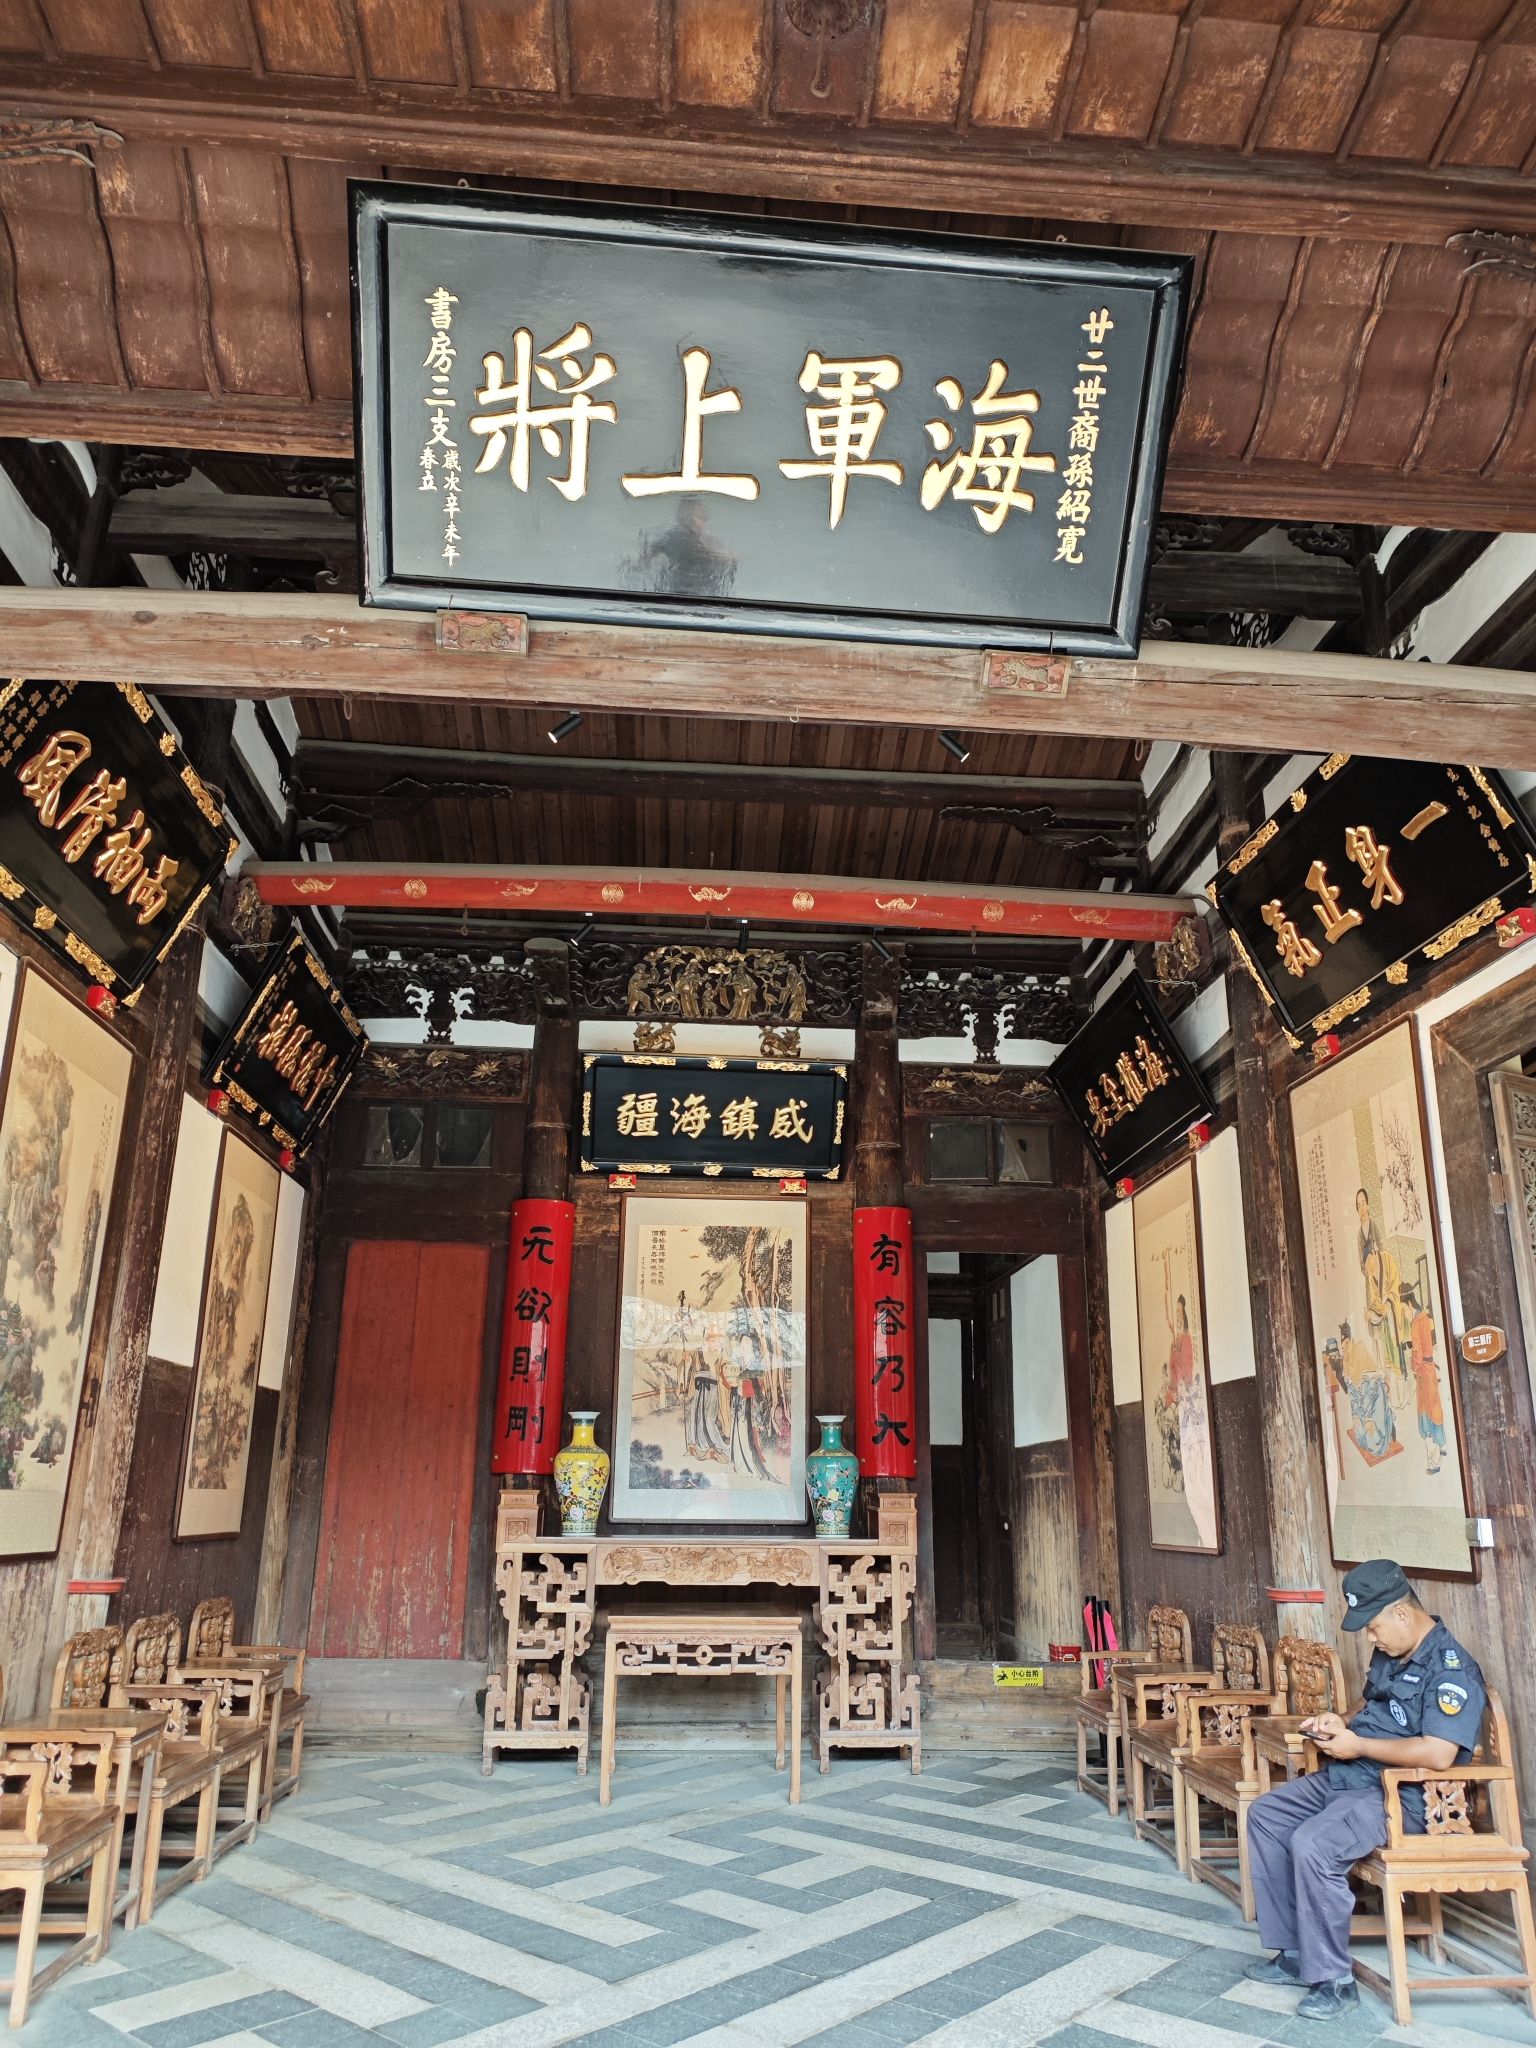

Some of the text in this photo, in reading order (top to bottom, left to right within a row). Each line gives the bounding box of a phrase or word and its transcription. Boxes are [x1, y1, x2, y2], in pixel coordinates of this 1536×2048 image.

[422, 286, 459, 446] 書房三支
[467, 320, 1058, 534] 海軍上將
[616, 1092, 814, 1144] 威鎮海疆
[870, 1234, 910, 1446] 有容乃大
[1011, 1669, 1039, 1678] 小心台阶
